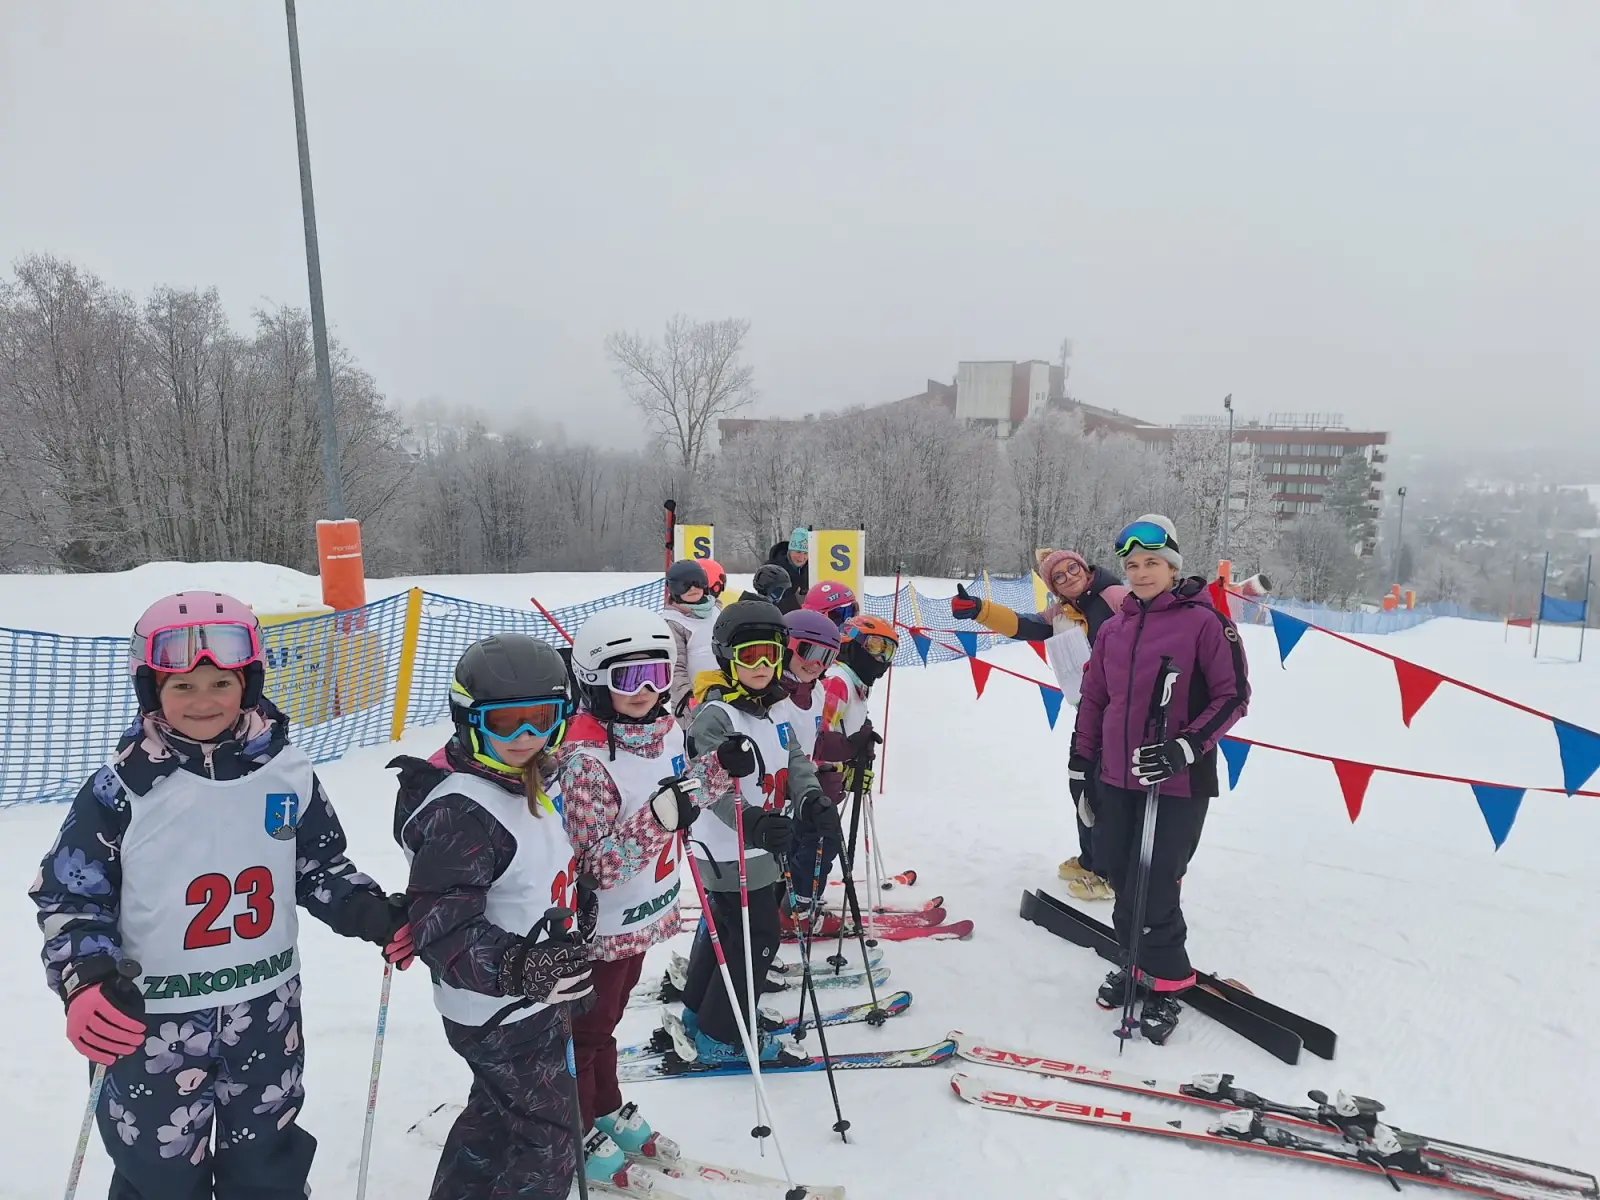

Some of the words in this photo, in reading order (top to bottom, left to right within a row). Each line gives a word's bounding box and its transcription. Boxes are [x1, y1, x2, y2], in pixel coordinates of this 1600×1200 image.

[693, 536, 711, 559] S
[829, 544, 851, 572] S
[183, 866, 275, 951] 23
[831, 1059, 904, 1070] NORDICA
[983, 1091, 1131, 1122] HEAD
